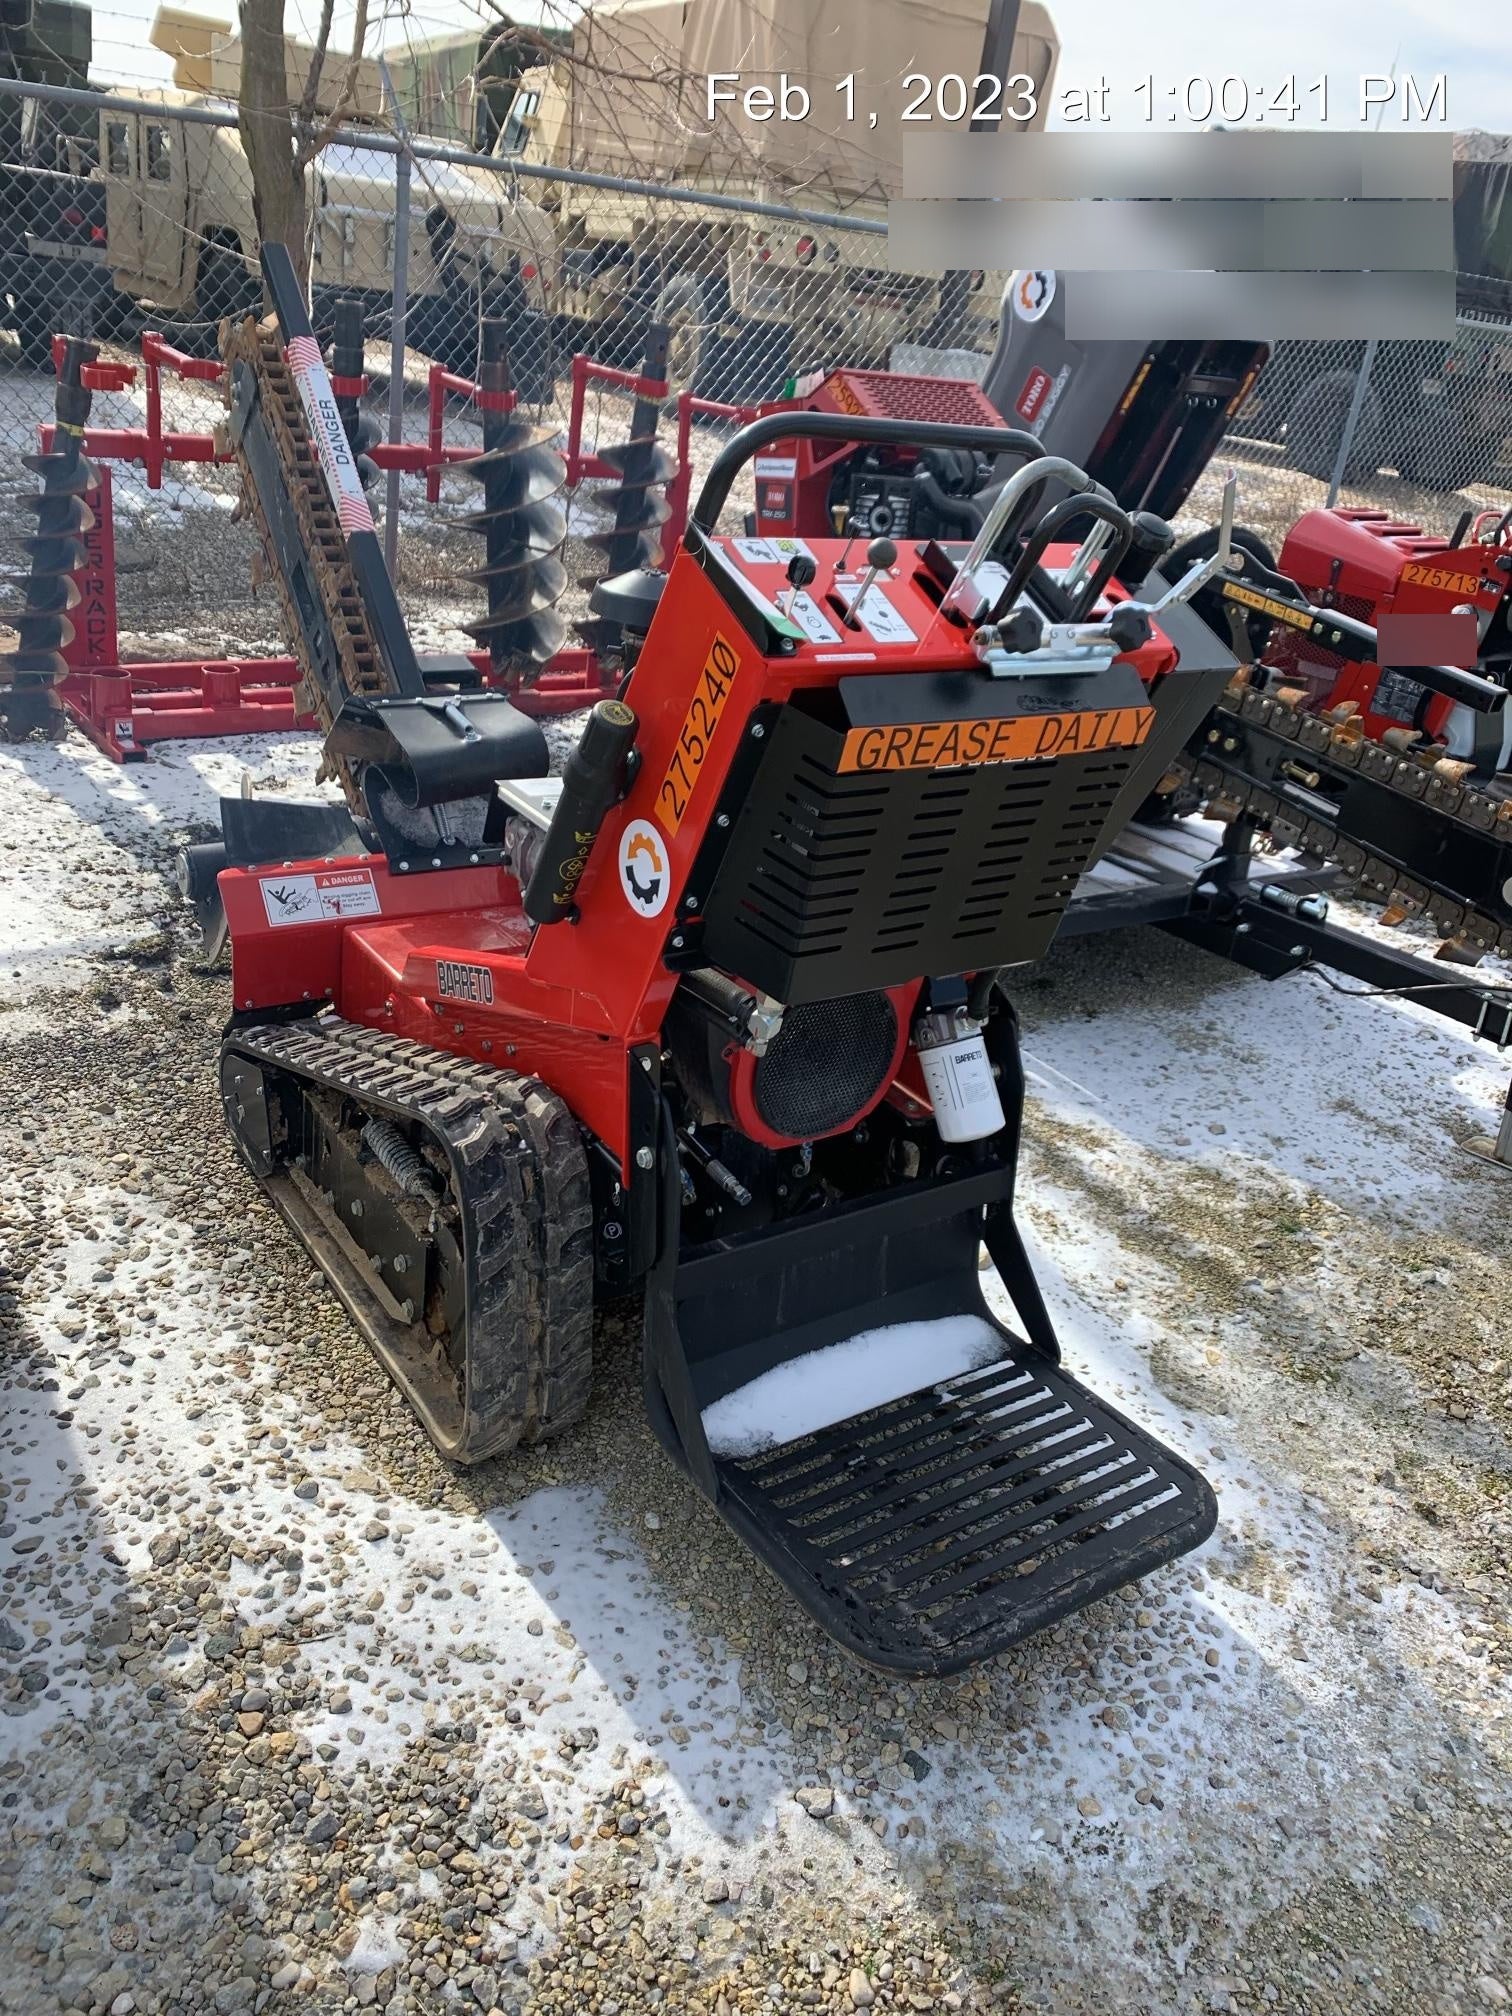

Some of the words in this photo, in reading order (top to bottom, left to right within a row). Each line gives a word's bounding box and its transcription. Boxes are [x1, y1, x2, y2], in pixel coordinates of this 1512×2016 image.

[1022, 375, 1045, 415] TORO
[319, 399, 350, 466] DANGER
[1407, 565, 1478, 594] 275713
[86, 579, 107, 654] RACK
[661, 636, 737, 821] 275240
[856, 719, 1017, 770] GREASE
[1036, 708, 1156, 755] DAILY
[331, 874, 365, 885] DANGER
[436, 960, 493, 1005] BARRETO
